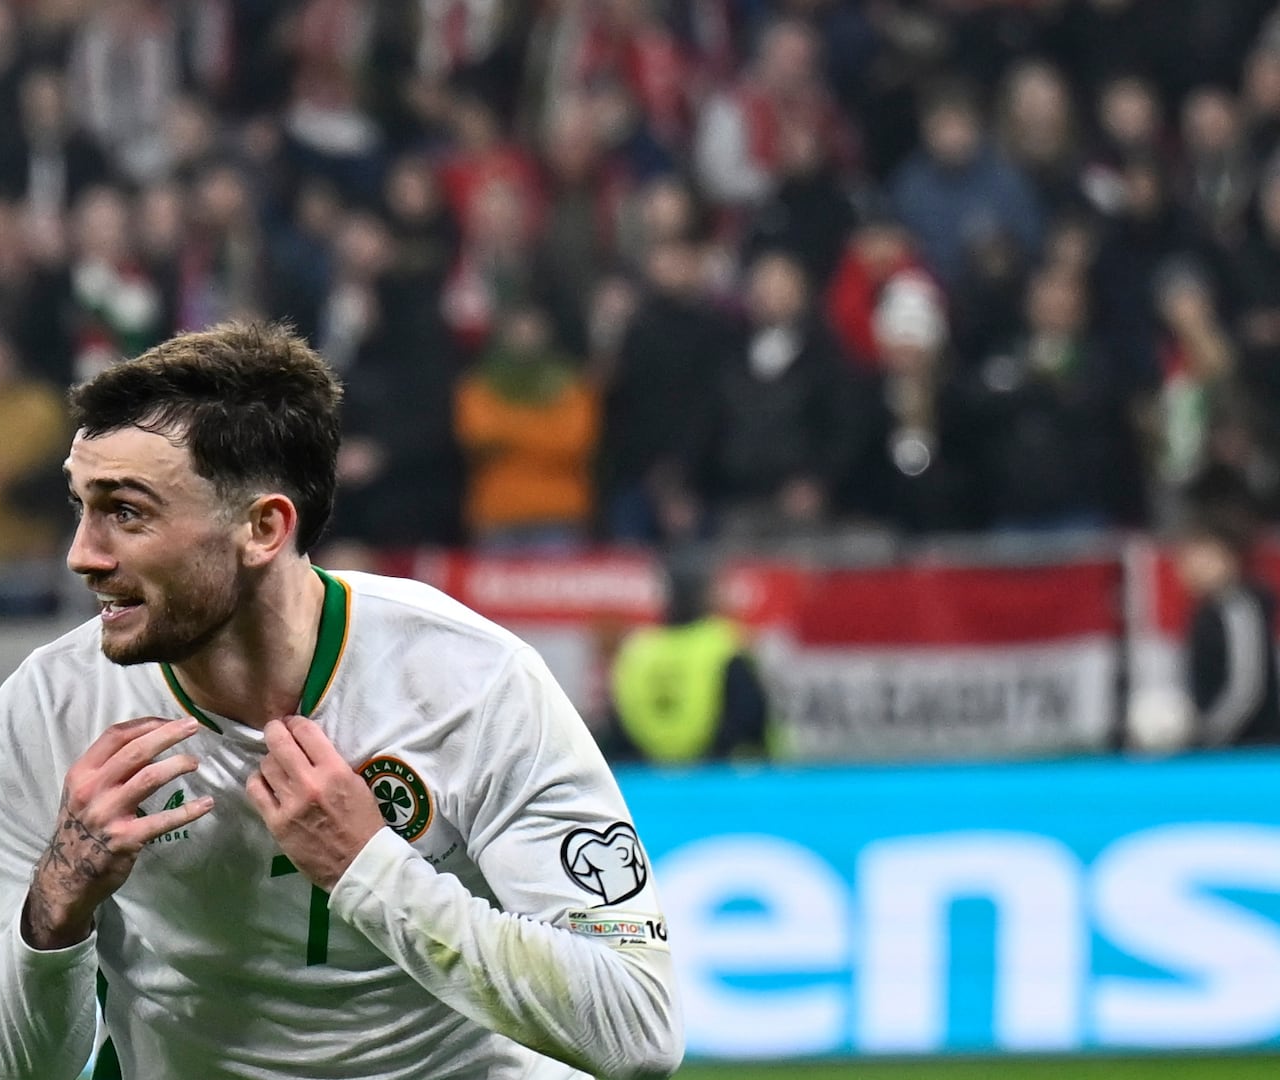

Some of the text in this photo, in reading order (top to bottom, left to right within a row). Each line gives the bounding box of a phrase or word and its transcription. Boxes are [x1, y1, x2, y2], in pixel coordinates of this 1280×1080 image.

[364, 761, 415, 783] ELAND
[271, 854, 330, 967] 7
[570, 922, 646, 935] FOUNDATION
